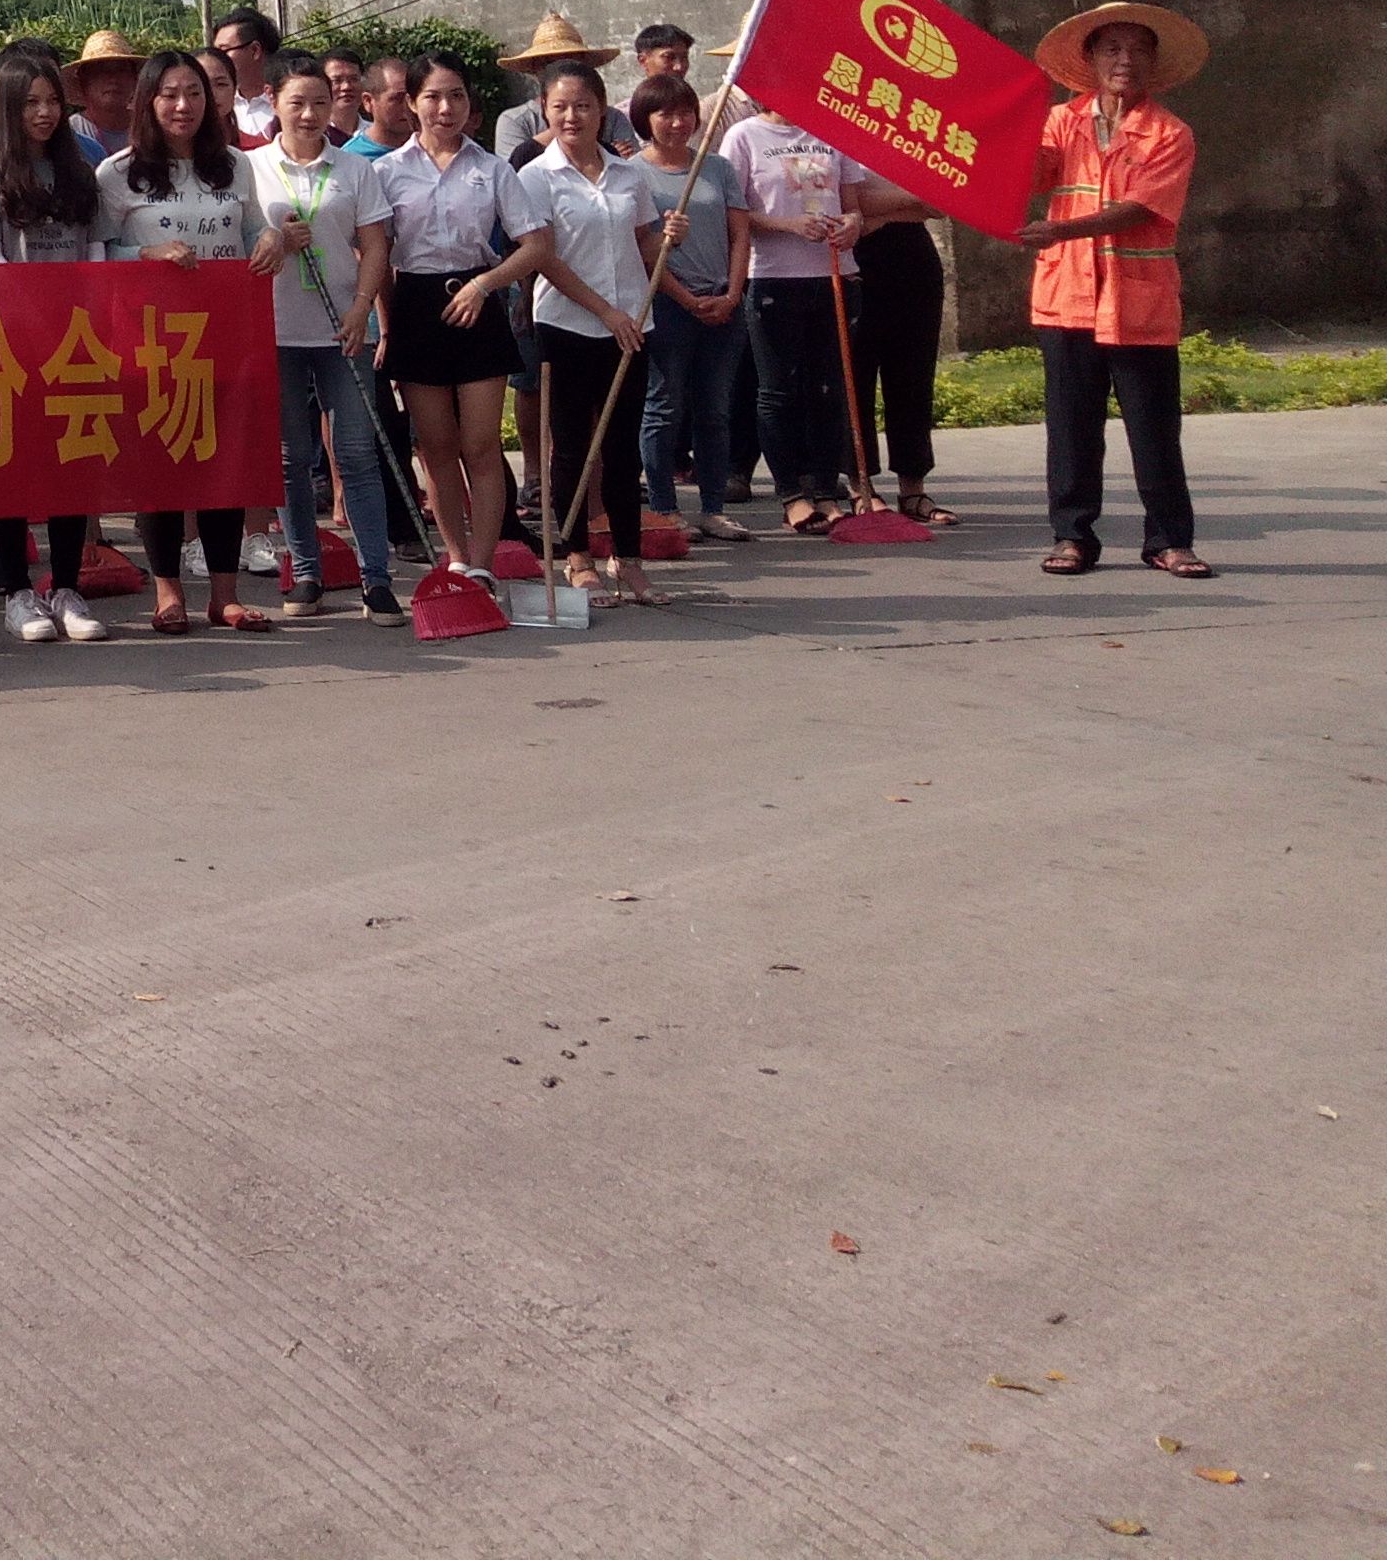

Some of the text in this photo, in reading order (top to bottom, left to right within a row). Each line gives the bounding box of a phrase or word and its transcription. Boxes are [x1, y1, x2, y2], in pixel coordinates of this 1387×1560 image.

[816, 86, 969, 188] Endian Tech Corp
[823, 52, 979, 166] 恩典科技
